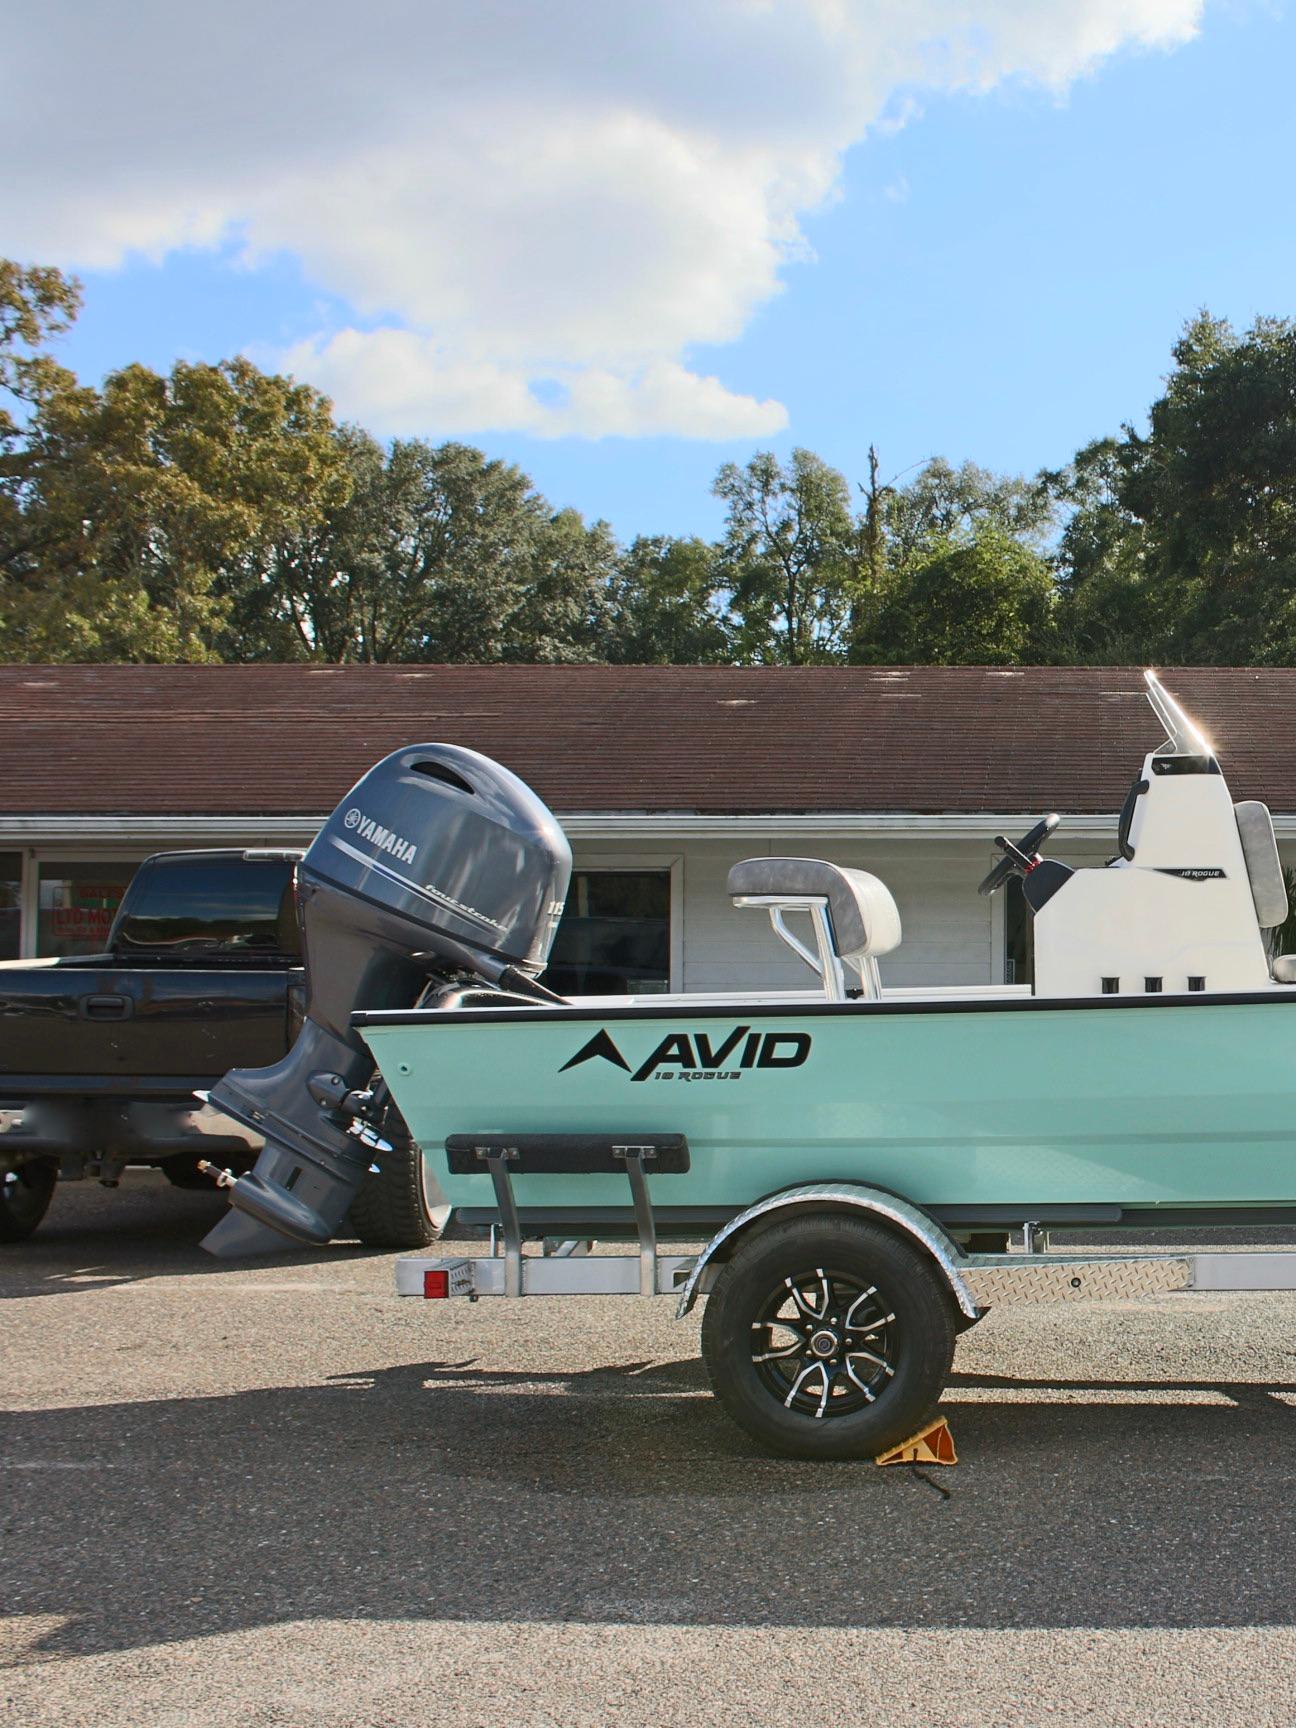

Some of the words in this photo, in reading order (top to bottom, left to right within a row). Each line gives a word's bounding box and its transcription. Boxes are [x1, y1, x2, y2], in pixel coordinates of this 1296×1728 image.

[356, 815, 417, 865] YAMAHA
[1191, 870, 1221, 878] ROGUE
[630, 1026, 812, 1081] AVID
[678, 1071, 741, 1082] ROGUE
